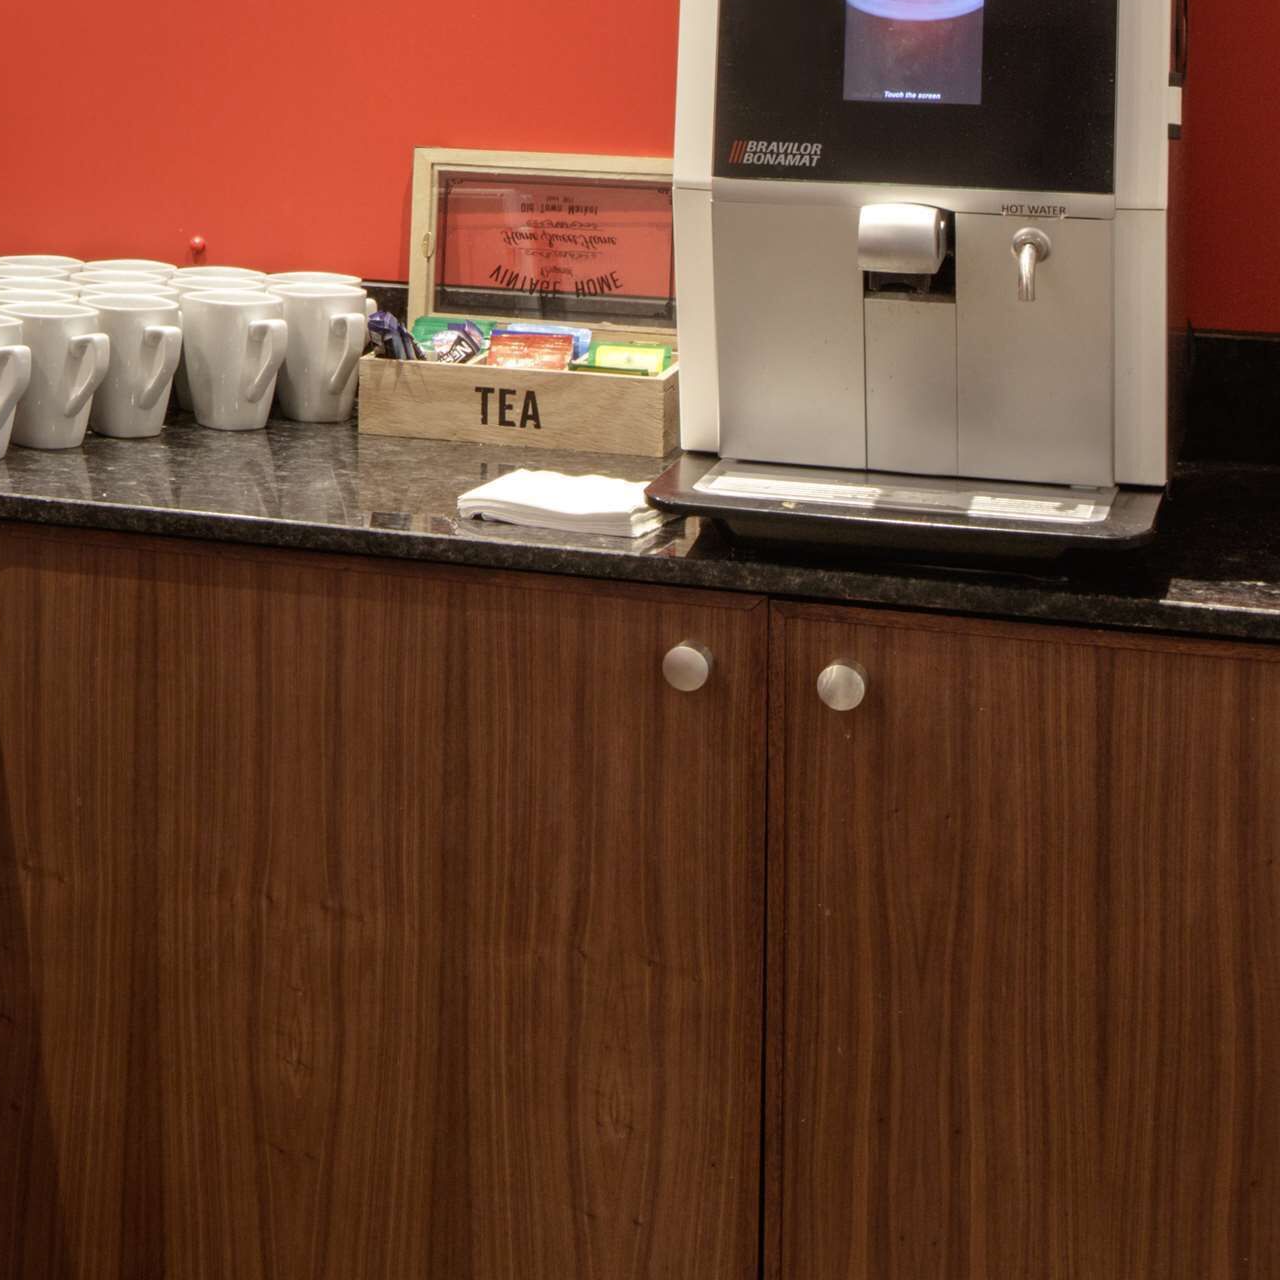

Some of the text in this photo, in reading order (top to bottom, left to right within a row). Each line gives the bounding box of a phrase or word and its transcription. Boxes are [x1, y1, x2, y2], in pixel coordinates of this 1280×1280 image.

[746, 140, 822, 155] BRAVILOR
[743, 152, 821, 167] BONAMAT
[1001, 204, 1066, 216] HOT WATER
[474, 386, 541, 429] TEA
